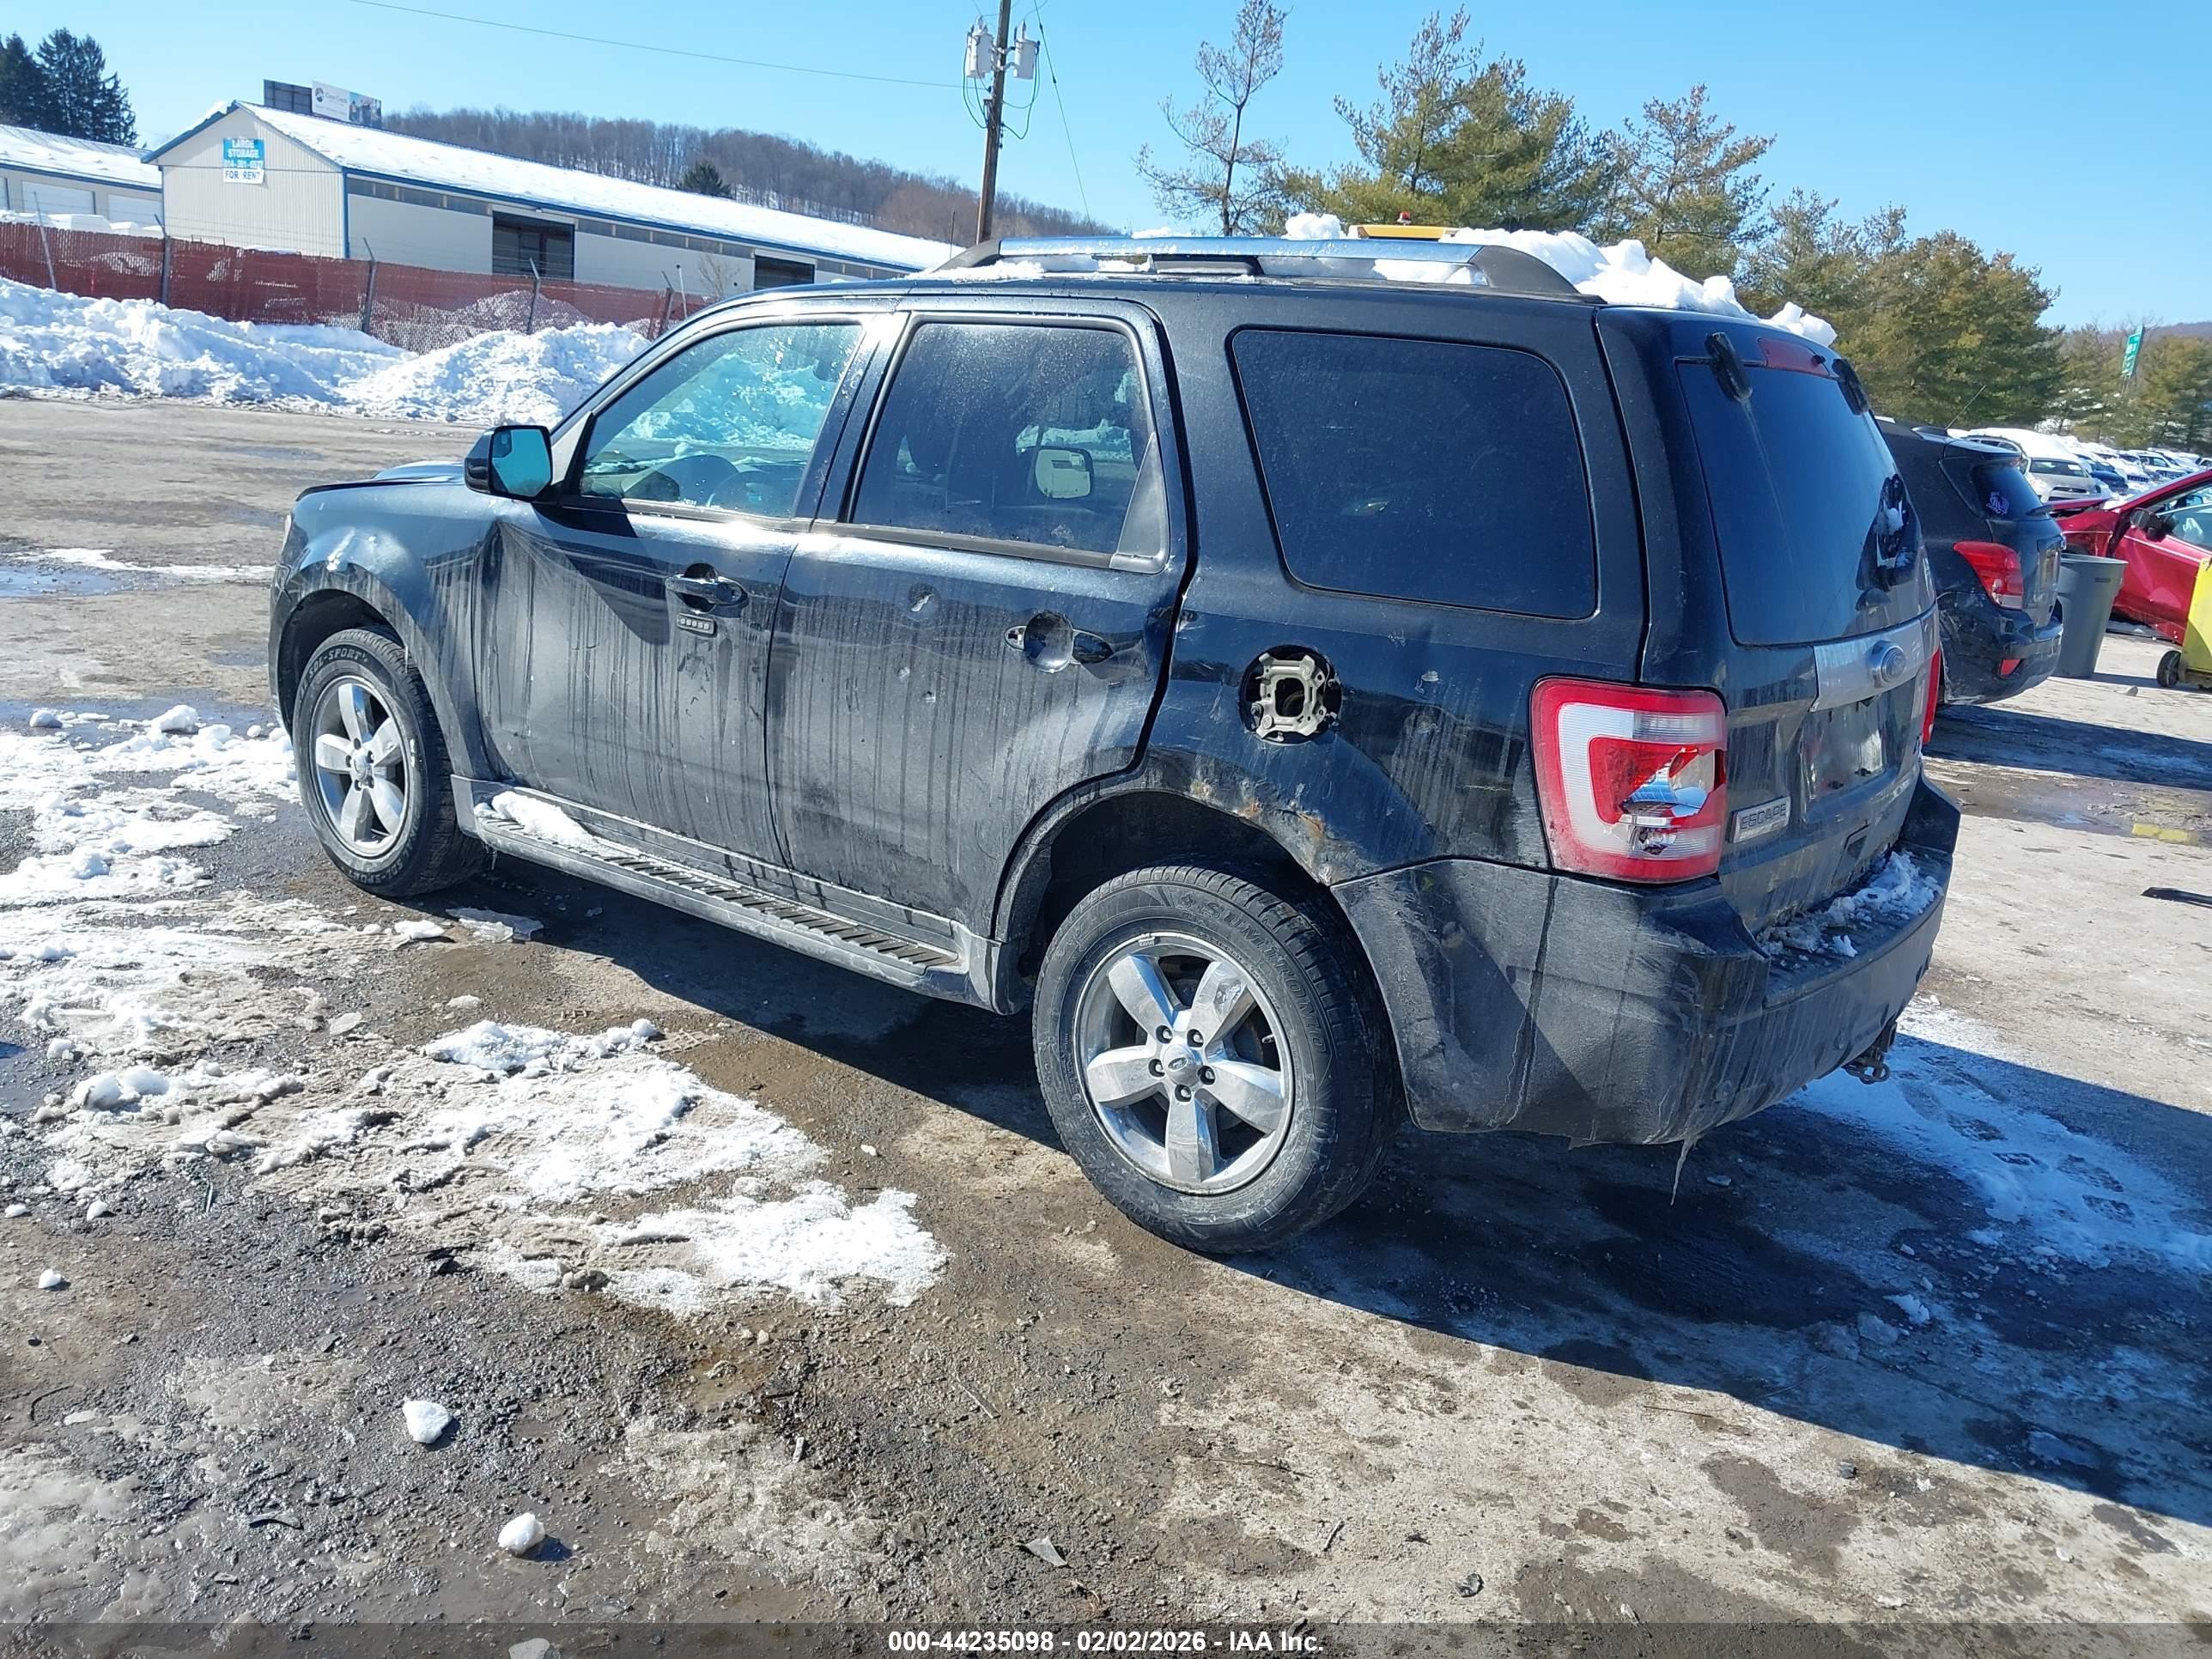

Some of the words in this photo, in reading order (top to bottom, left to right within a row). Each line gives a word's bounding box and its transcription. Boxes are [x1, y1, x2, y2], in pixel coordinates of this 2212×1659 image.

[231, 139, 255, 149] LARGE
[228, 149, 260, 158] STORAGE
[225, 170, 239, 179] FOR
[242, 171, 261, 180] RENT
[1741, 804, 1786, 830] ESCAPE
[1201, 900, 1327, 1053] SUMITOMO
